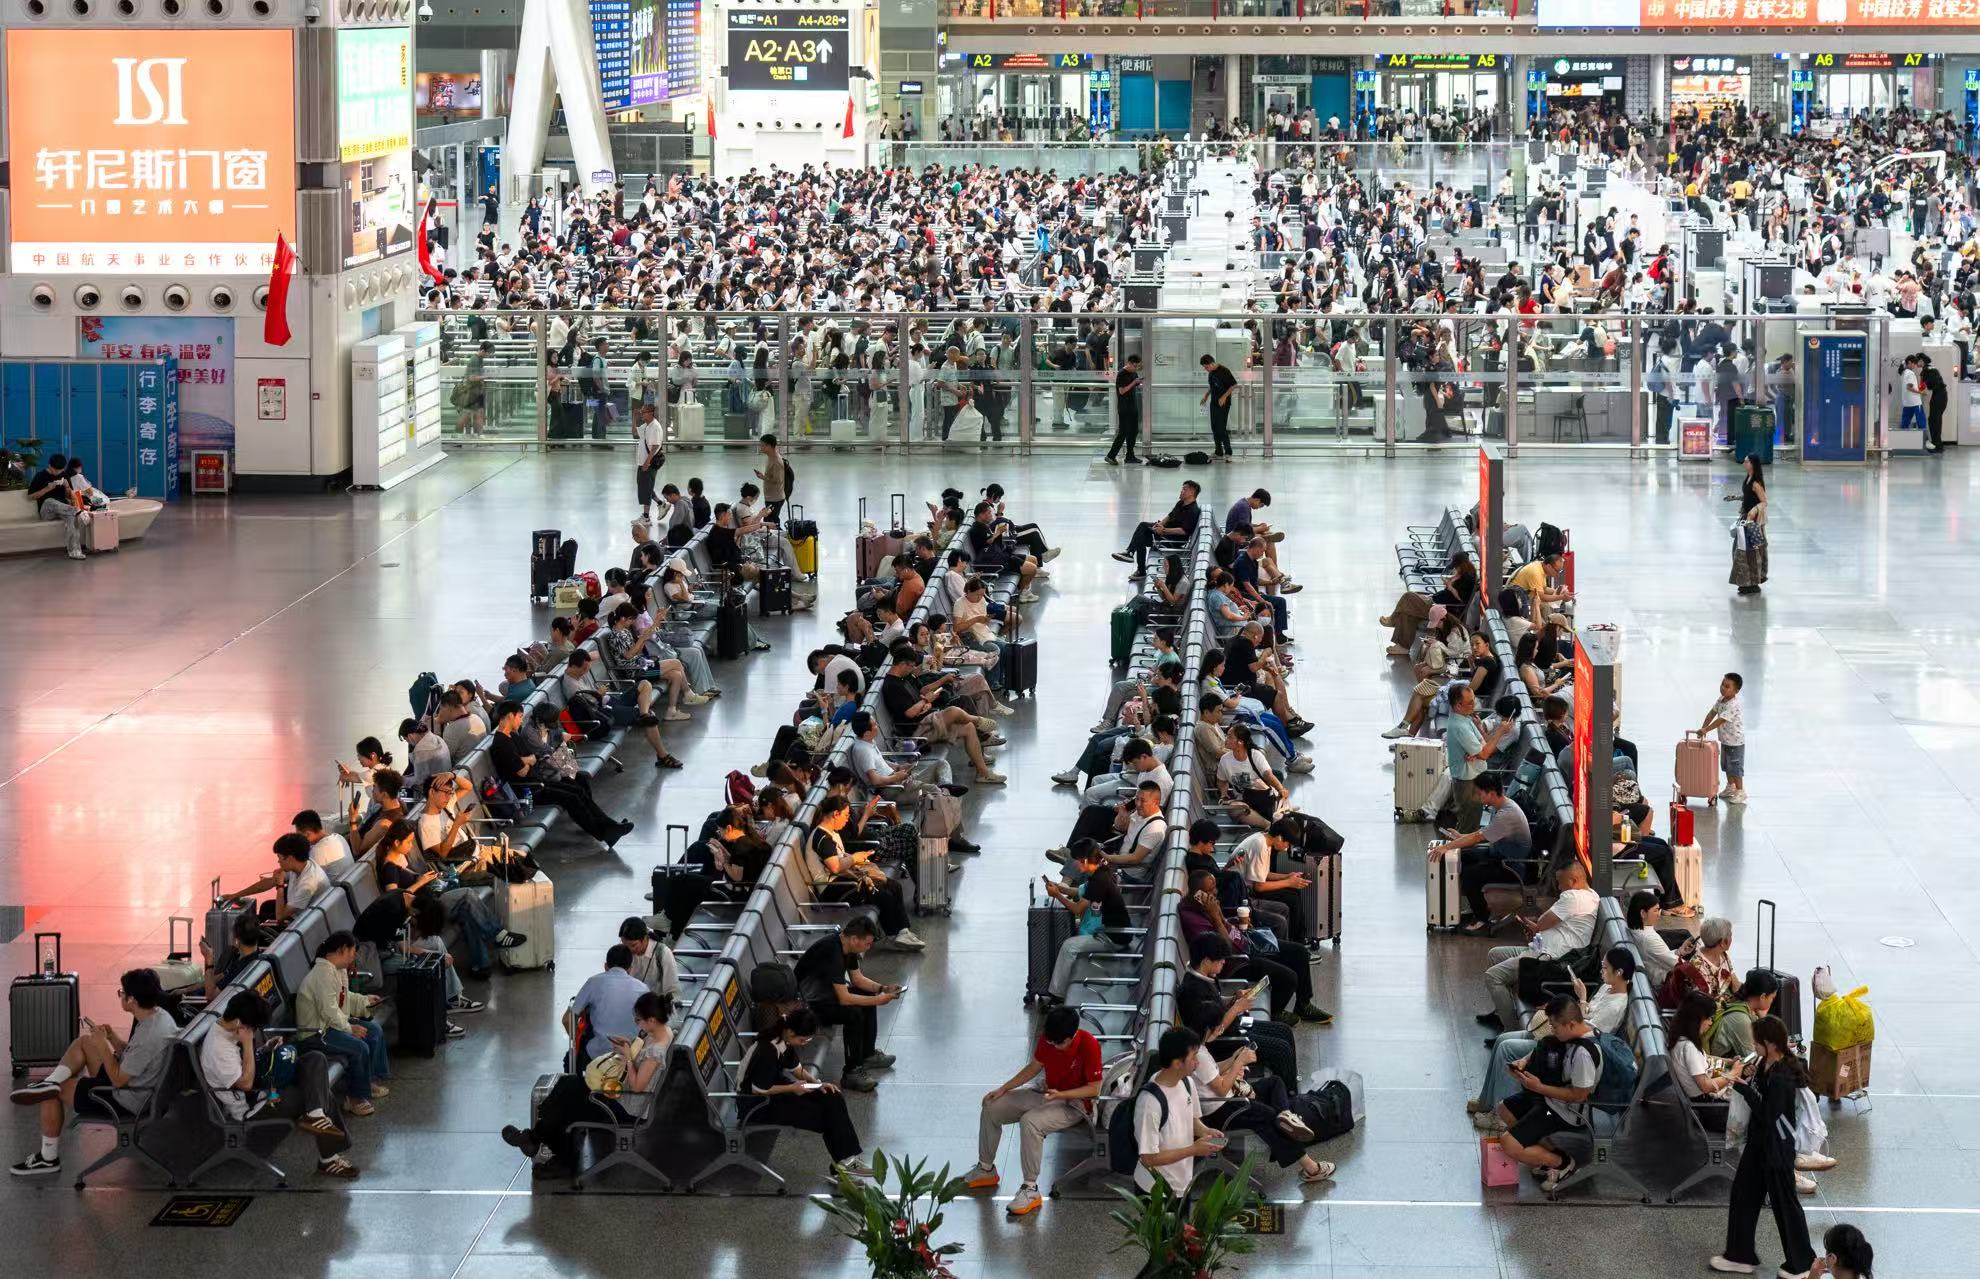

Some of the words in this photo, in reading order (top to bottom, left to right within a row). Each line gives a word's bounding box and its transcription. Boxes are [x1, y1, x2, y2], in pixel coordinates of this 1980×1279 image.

[1674, 0, 1738, 19] 中国拉芳
[1743, 0, 1807, 19] 冠军之选
[1858, 0, 1923, 19] 中国拉芳
[1928, 0, 1980, 19] 冠军之
[763, 15, 778, 25] A1
[798, 15, 839, 26] A4-A28
[973, 54, 992, 67] A2
[1060, 54, 1079, 67] A3
[1388, 54, 1407, 66] A4
[1476, 54, 1496, 67] A5
[1815, 53, 1834, 66] A6
[1904, 53, 1923, 66] A7
[35, 147, 269, 190] 轩尼斯门窗
[32, 252, 275, 267] 中国航天事业合作伙伴
[101, 344, 133, 359] 平安
[179, 344, 212, 360] 温馨
[177, 368, 226, 384] 更美好
[138, 370, 157, 466] 行李寄存
